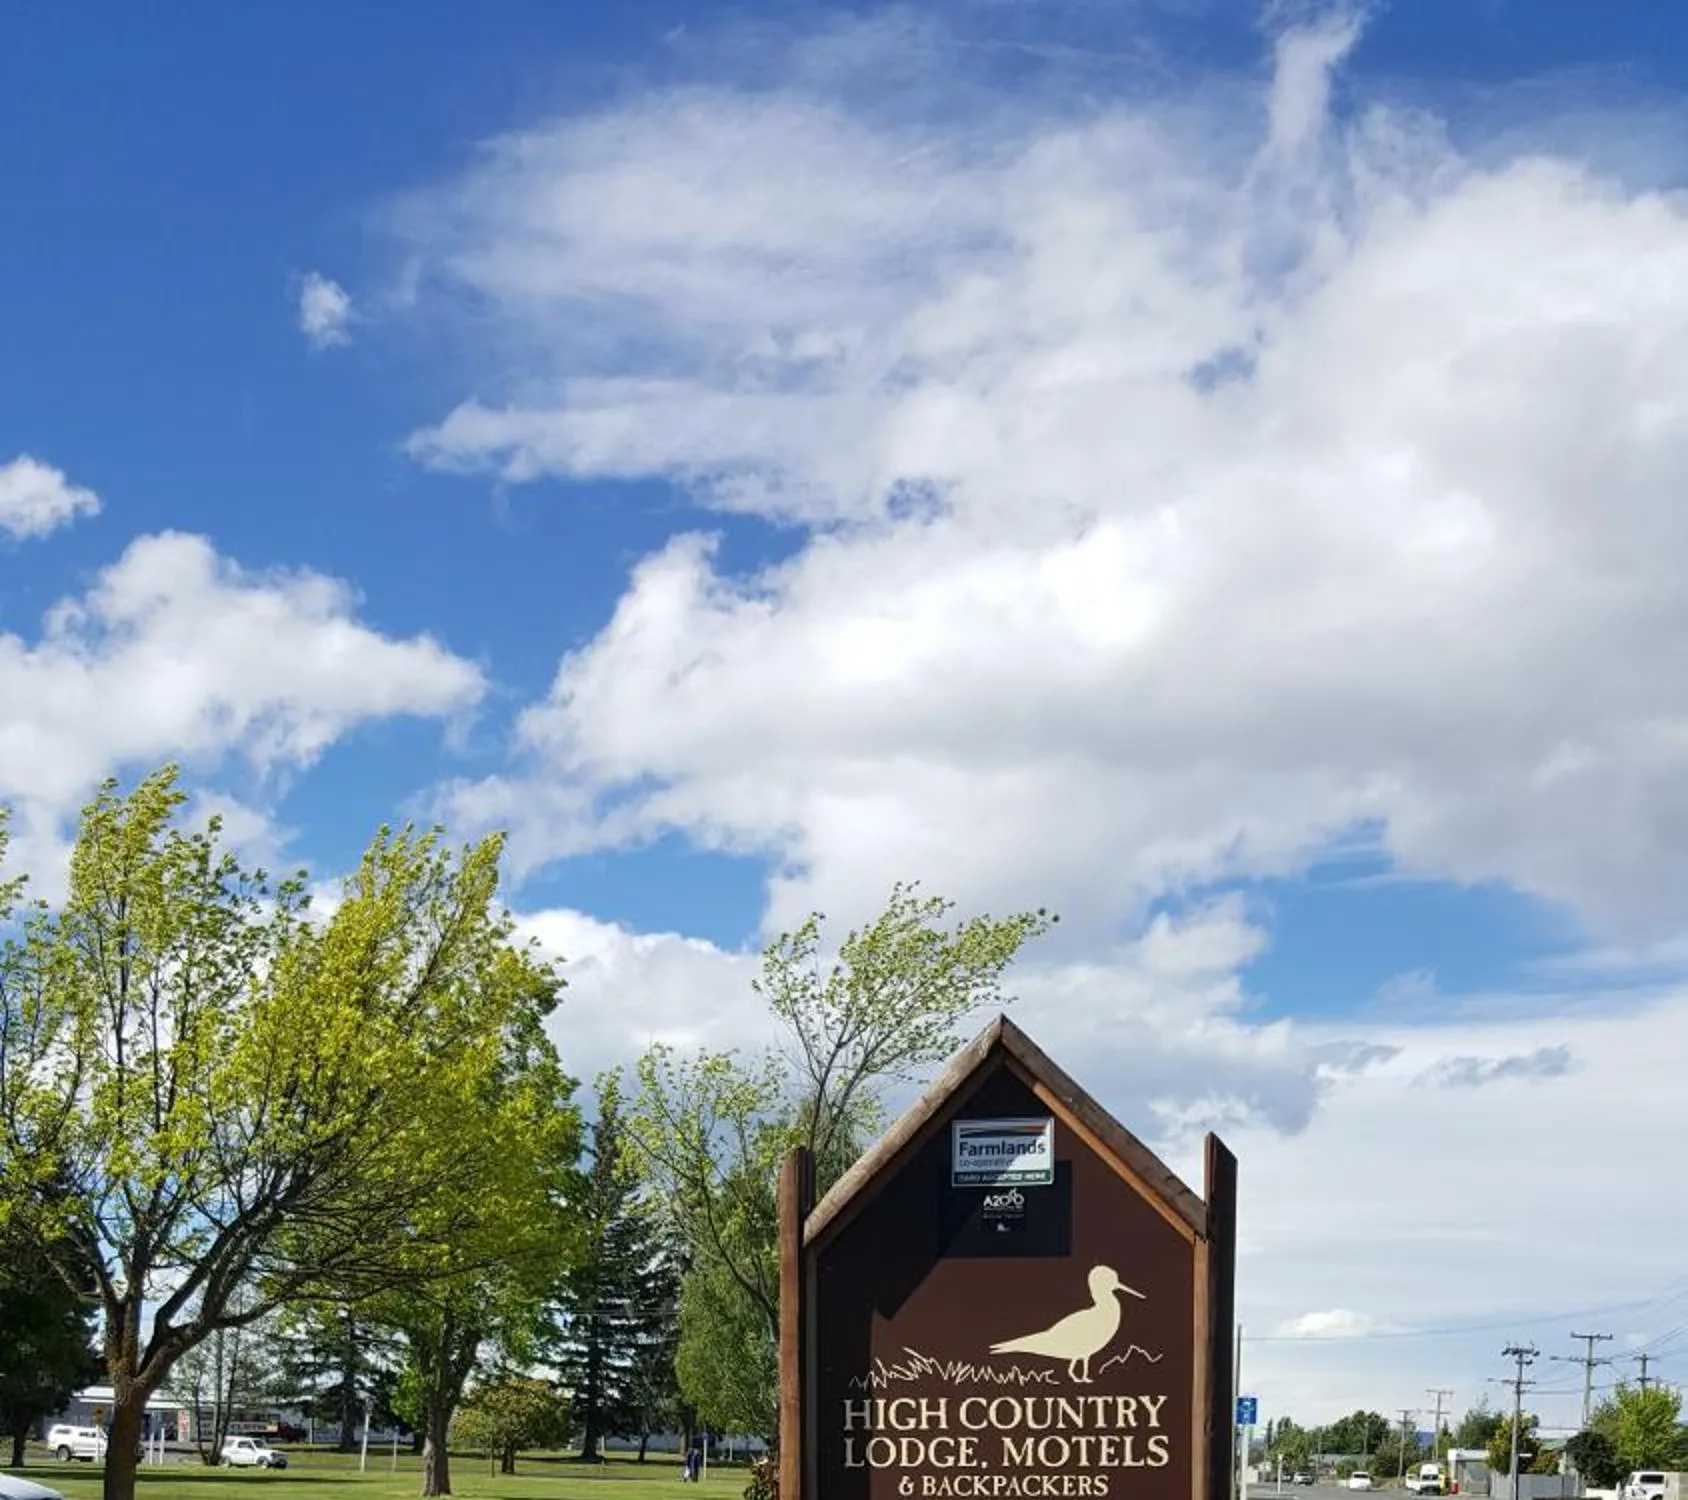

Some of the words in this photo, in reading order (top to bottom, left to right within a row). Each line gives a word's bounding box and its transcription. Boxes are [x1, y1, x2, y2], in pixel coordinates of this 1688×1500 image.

[960, 1140, 1045, 1156] Farmlands
[844, 1397, 947, 1430] HIGH
[959, 1396, 1167, 1429] COUNTRY
[1002, 1436, 1169, 1467] MOTELS
[899, 1477, 914, 1496] &
[922, 1475, 1109, 1497] BACKPACKERS
